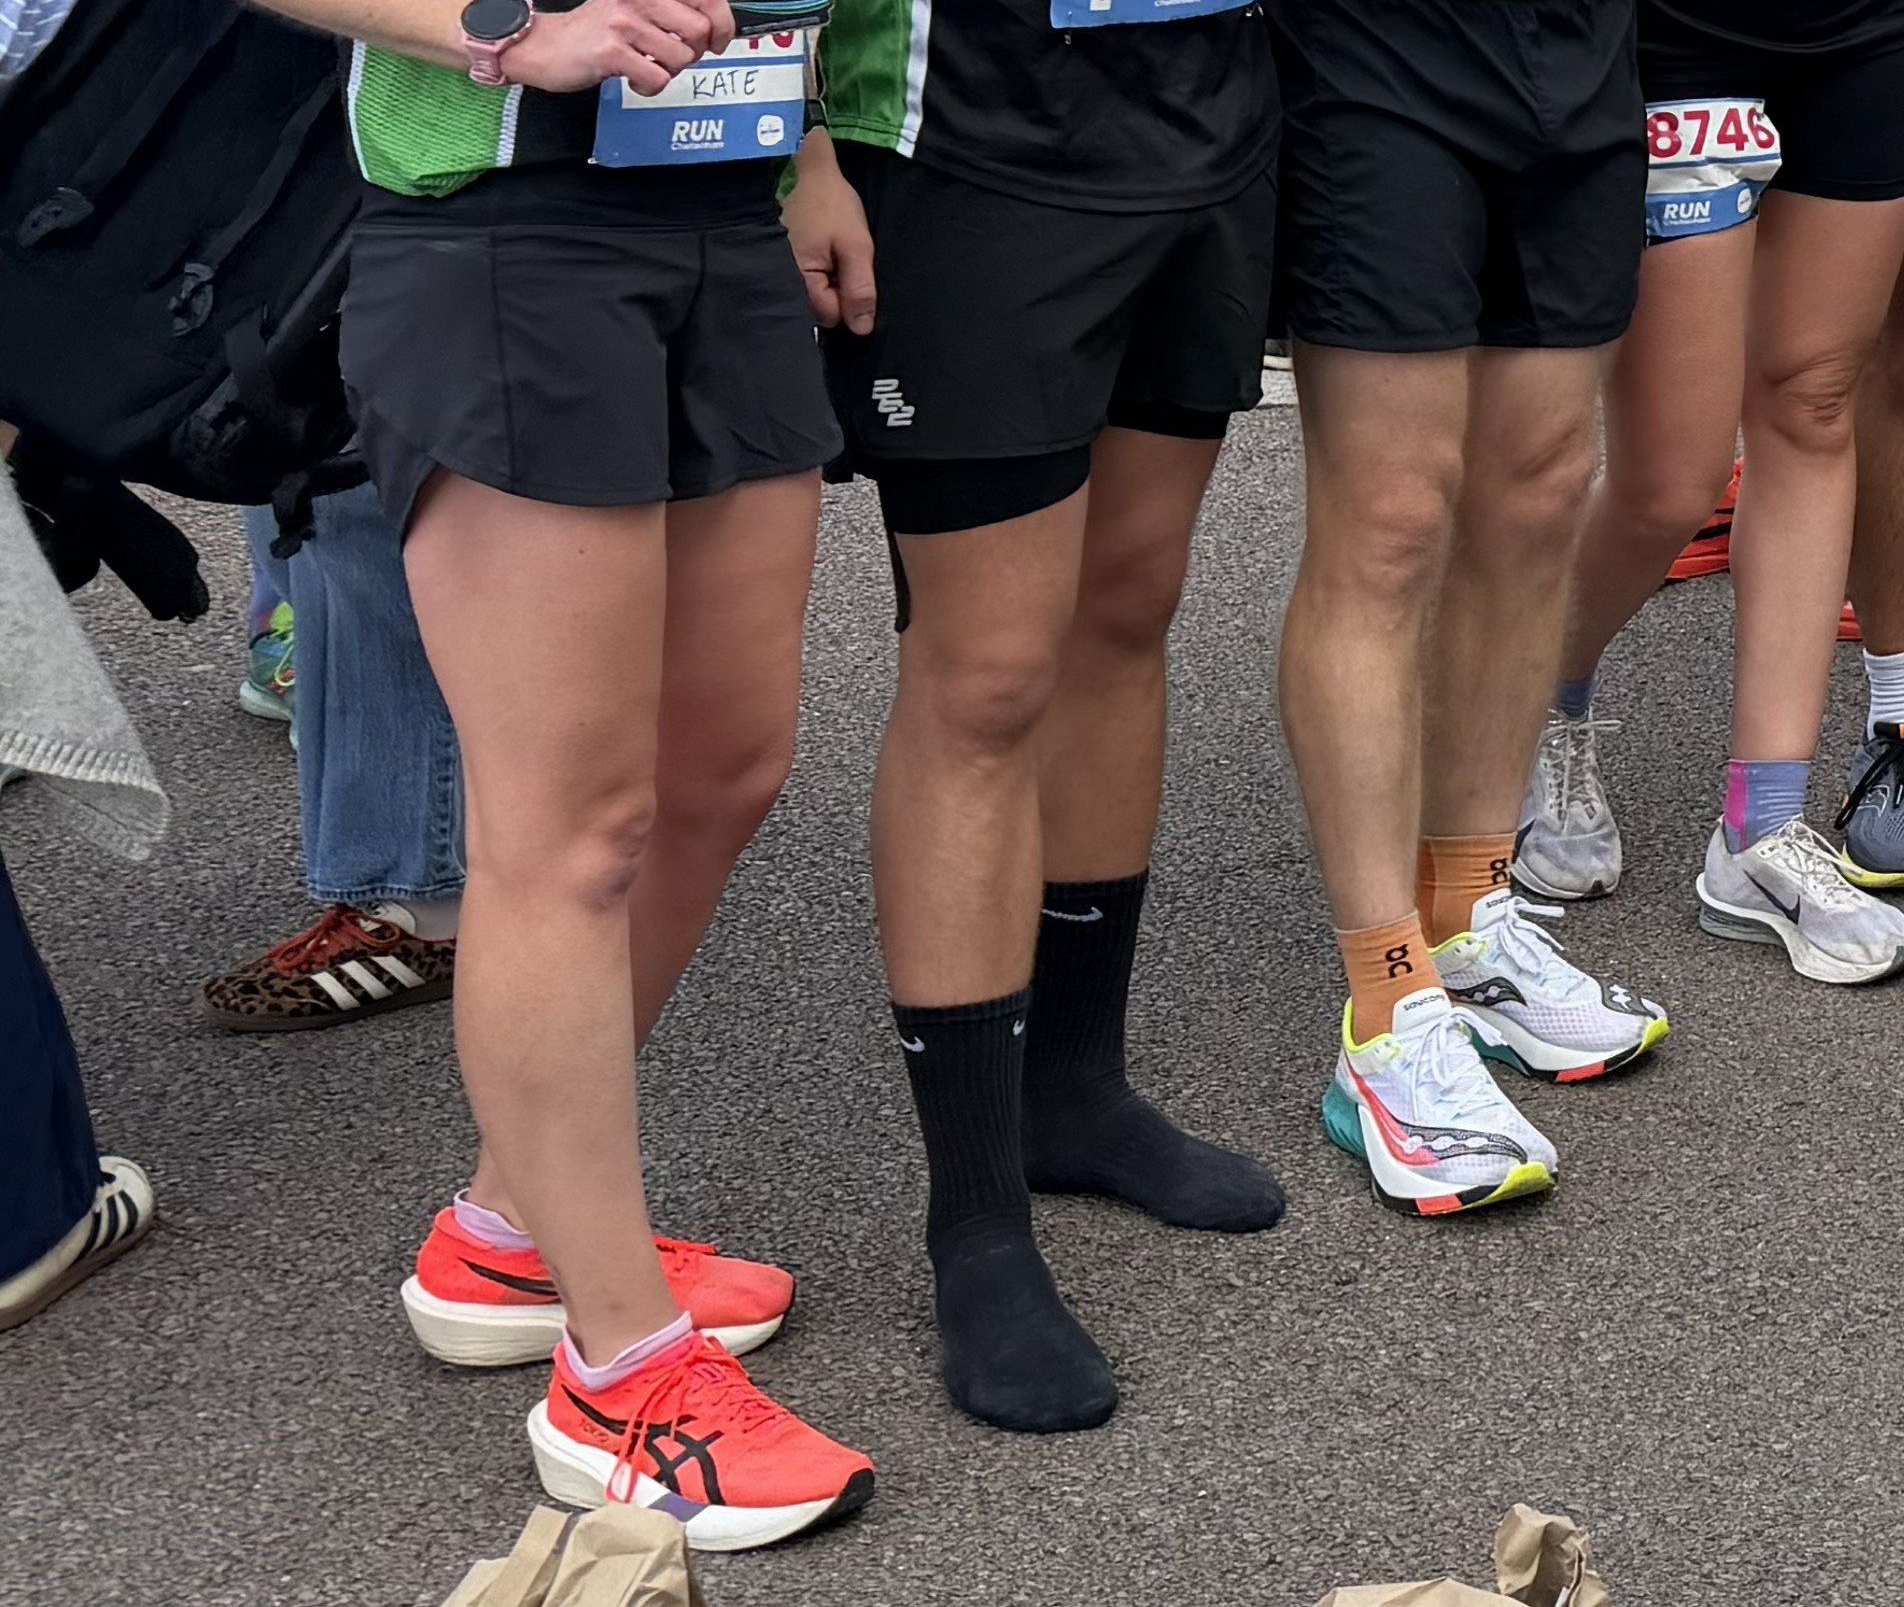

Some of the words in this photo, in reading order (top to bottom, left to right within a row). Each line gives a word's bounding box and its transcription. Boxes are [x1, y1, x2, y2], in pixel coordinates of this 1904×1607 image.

[691, 70, 759, 98] KATE
[671, 119, 724, 142] RUN
[1646, 107, 1775, 158] 8746
[1664, 201, 1711, 219] RUN
